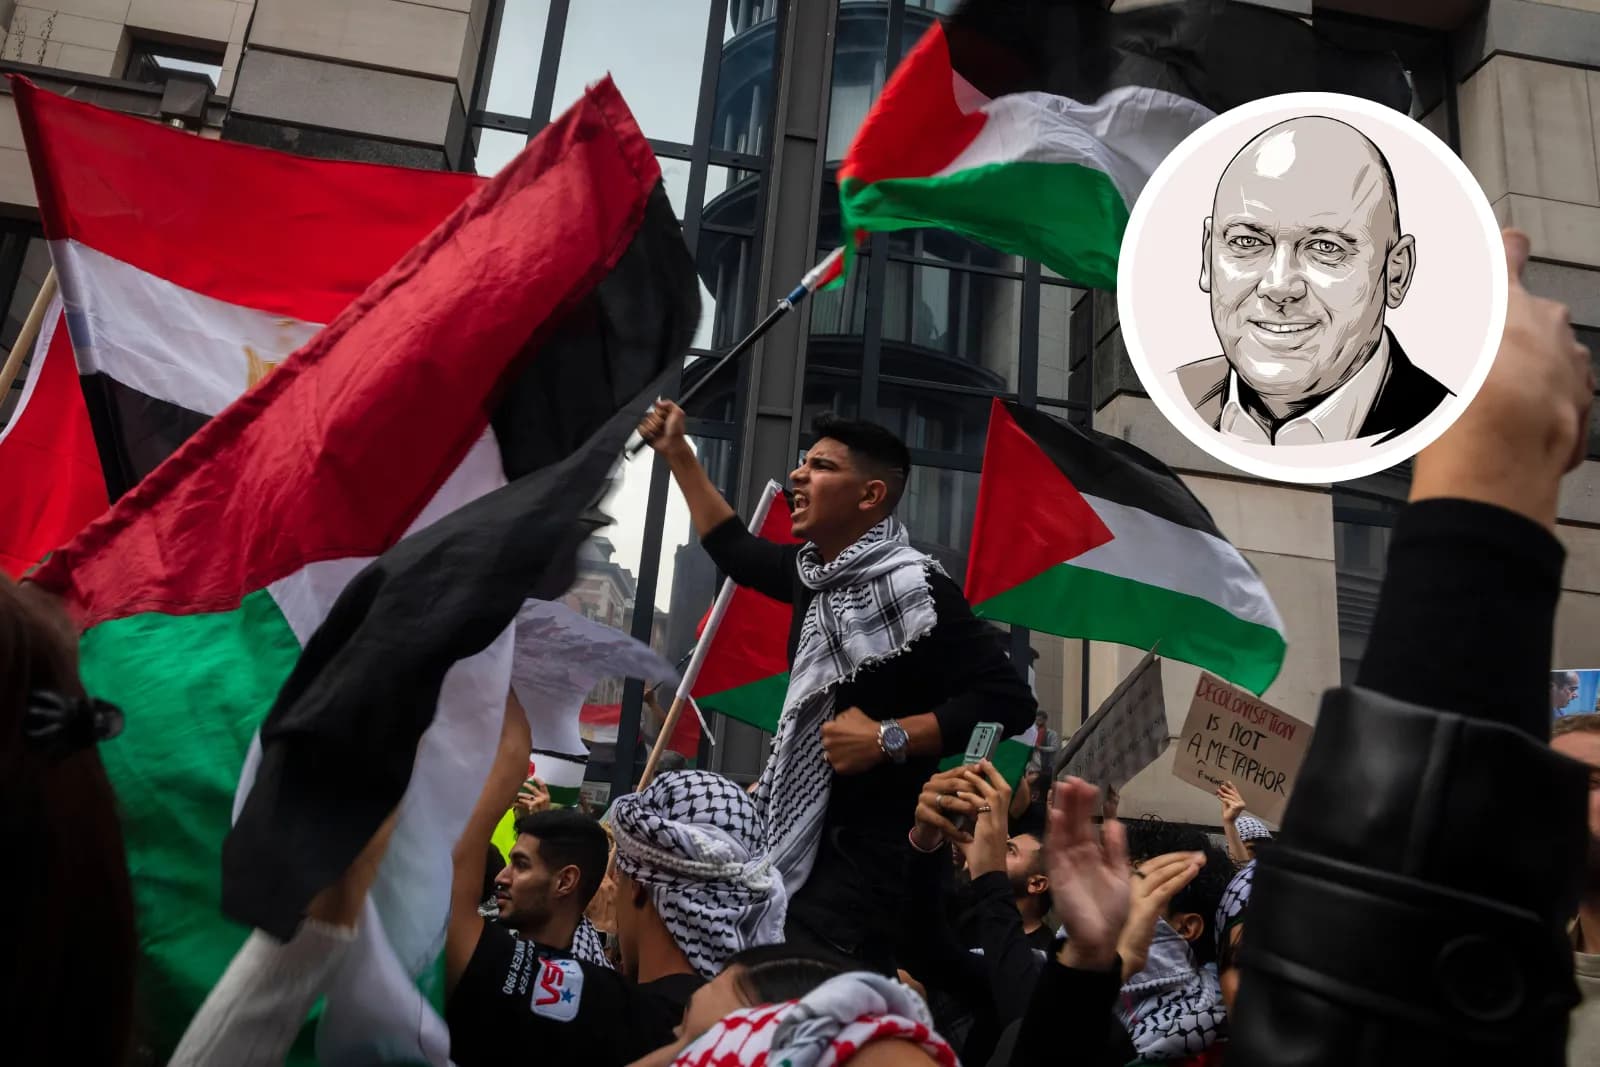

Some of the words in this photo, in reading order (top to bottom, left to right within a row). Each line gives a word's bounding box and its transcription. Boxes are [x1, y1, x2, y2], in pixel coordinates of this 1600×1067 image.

[1196, 675, 1297, 740] DECOLONISATION
[1206, 712, 1221, 731] IS
[1229, 721, 1268, 750] NOT
[1186, 732, 1203, 758] A
[1206, 739, 1286, 797] METAPHOR
[502, 969, 518, 994] 1990
